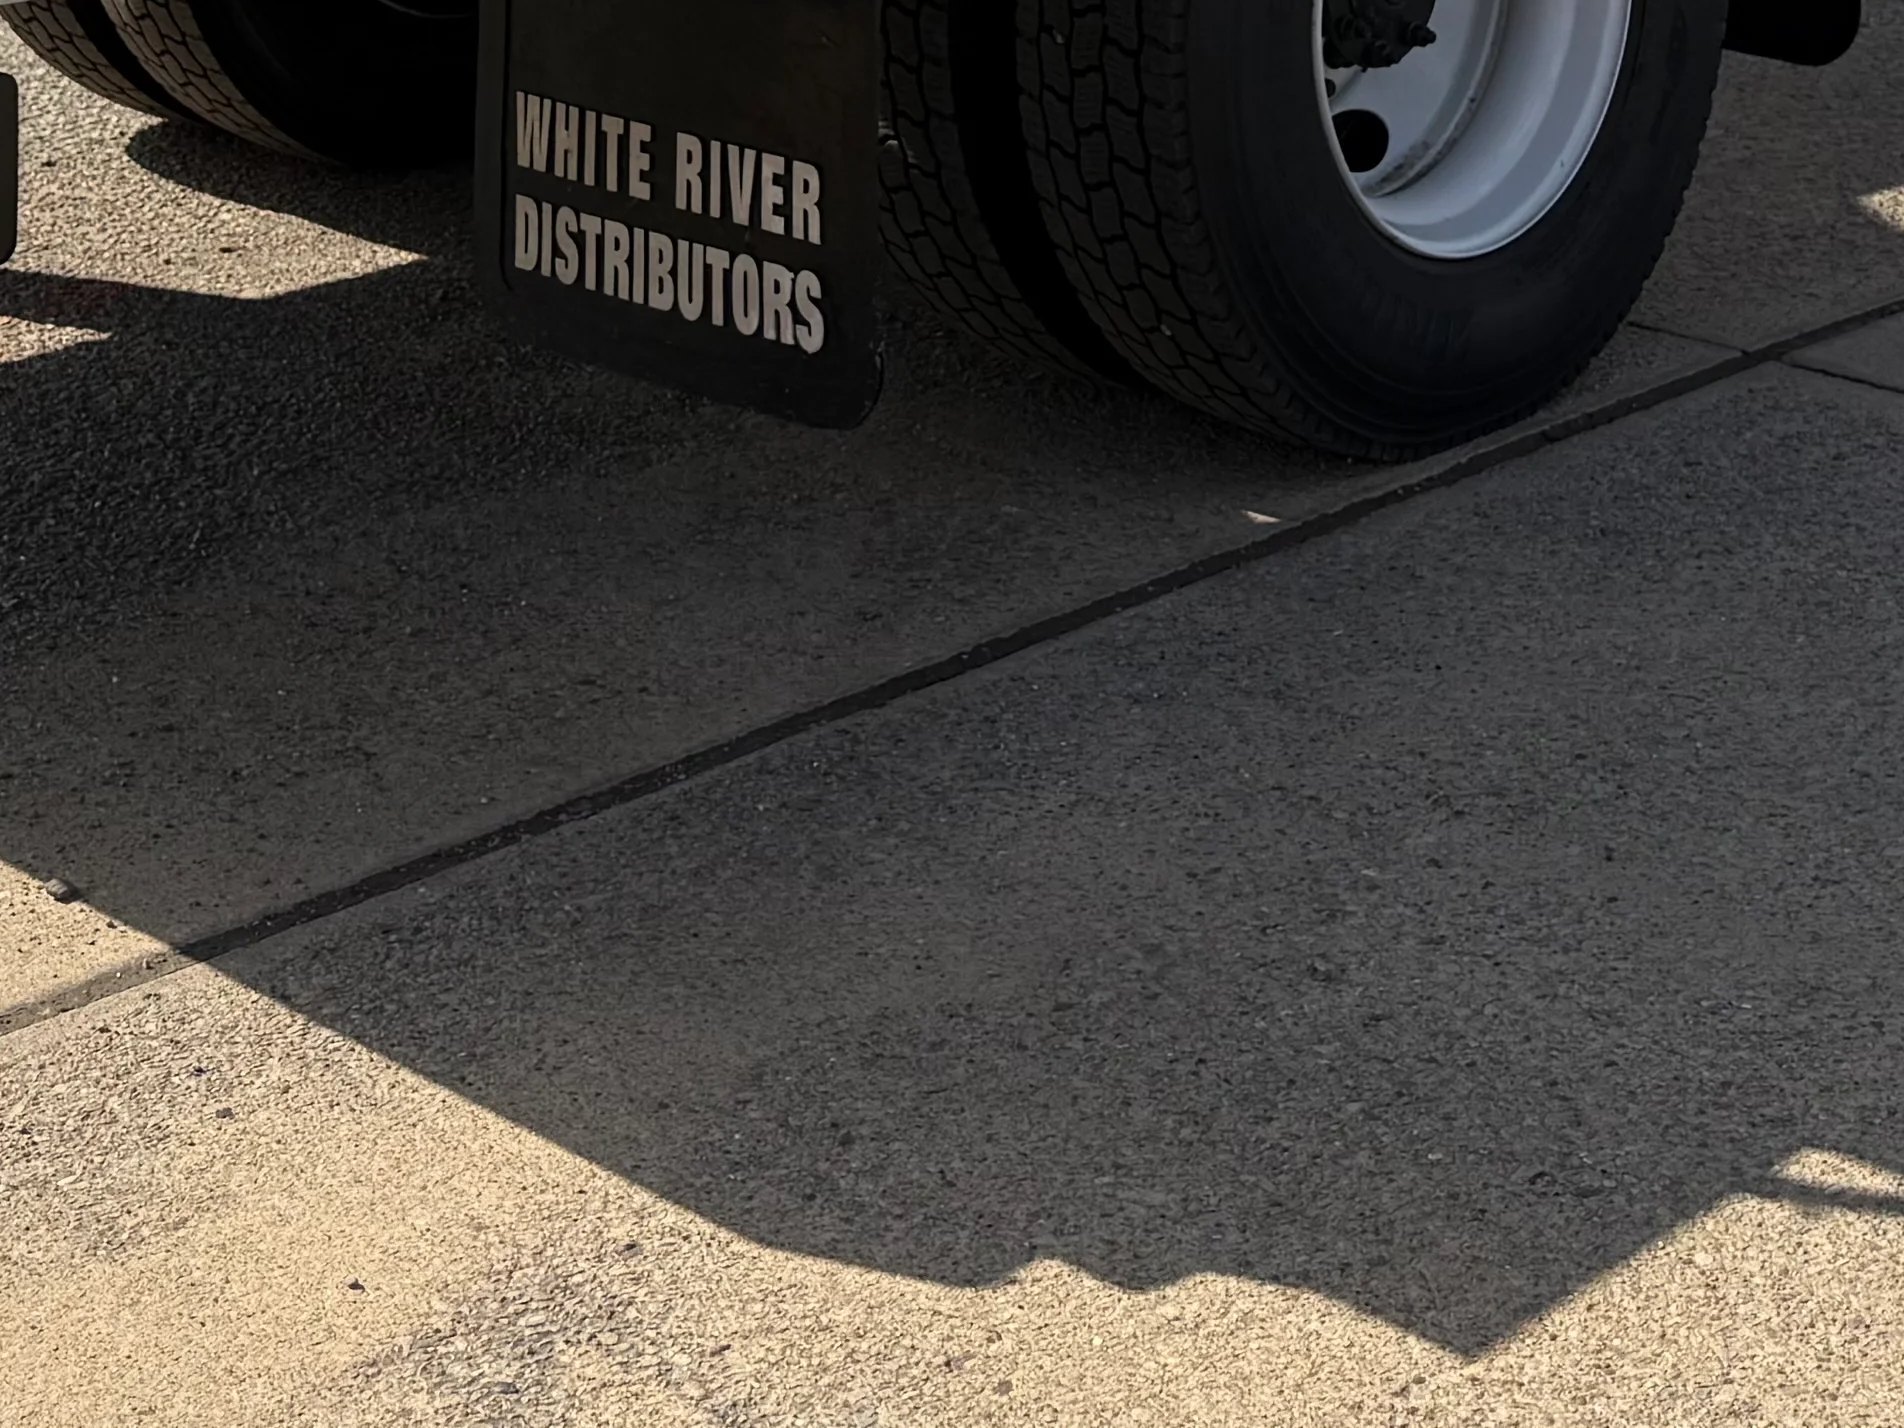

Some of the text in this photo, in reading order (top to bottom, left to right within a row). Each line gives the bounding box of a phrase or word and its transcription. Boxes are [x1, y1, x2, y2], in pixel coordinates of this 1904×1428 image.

[516, 91, 822, 245] WHITE RIVER
[514, 194, 825, 354] DISTRIBUTORS
